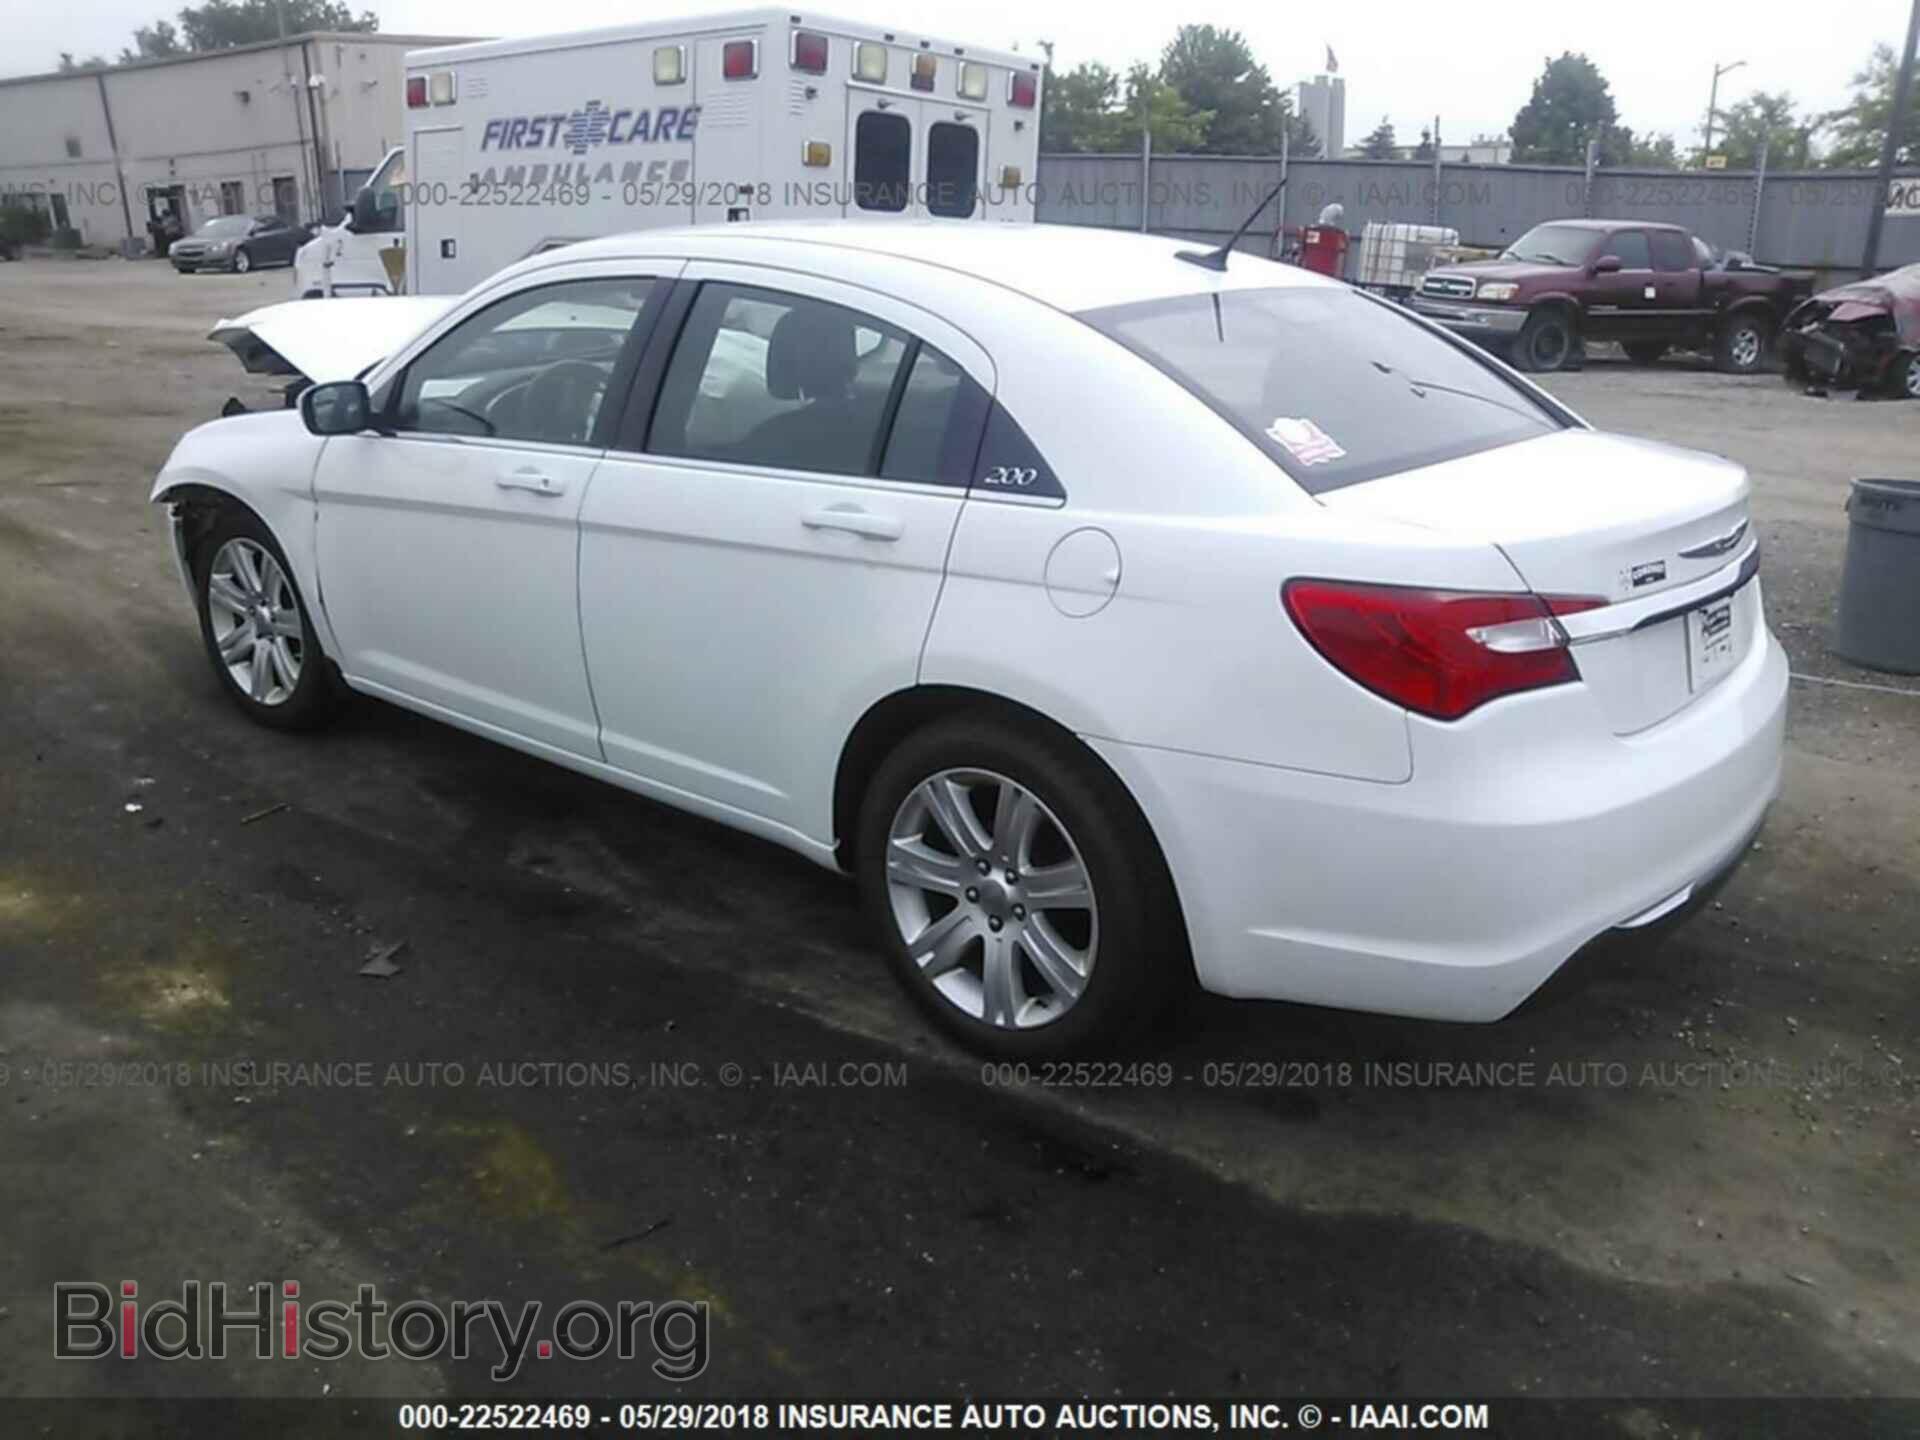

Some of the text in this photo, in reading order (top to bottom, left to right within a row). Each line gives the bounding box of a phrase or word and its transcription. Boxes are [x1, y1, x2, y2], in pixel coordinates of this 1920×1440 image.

[481, 106, 702, 151] FIRST CARE
[984, 466, 1038, 486] 200
